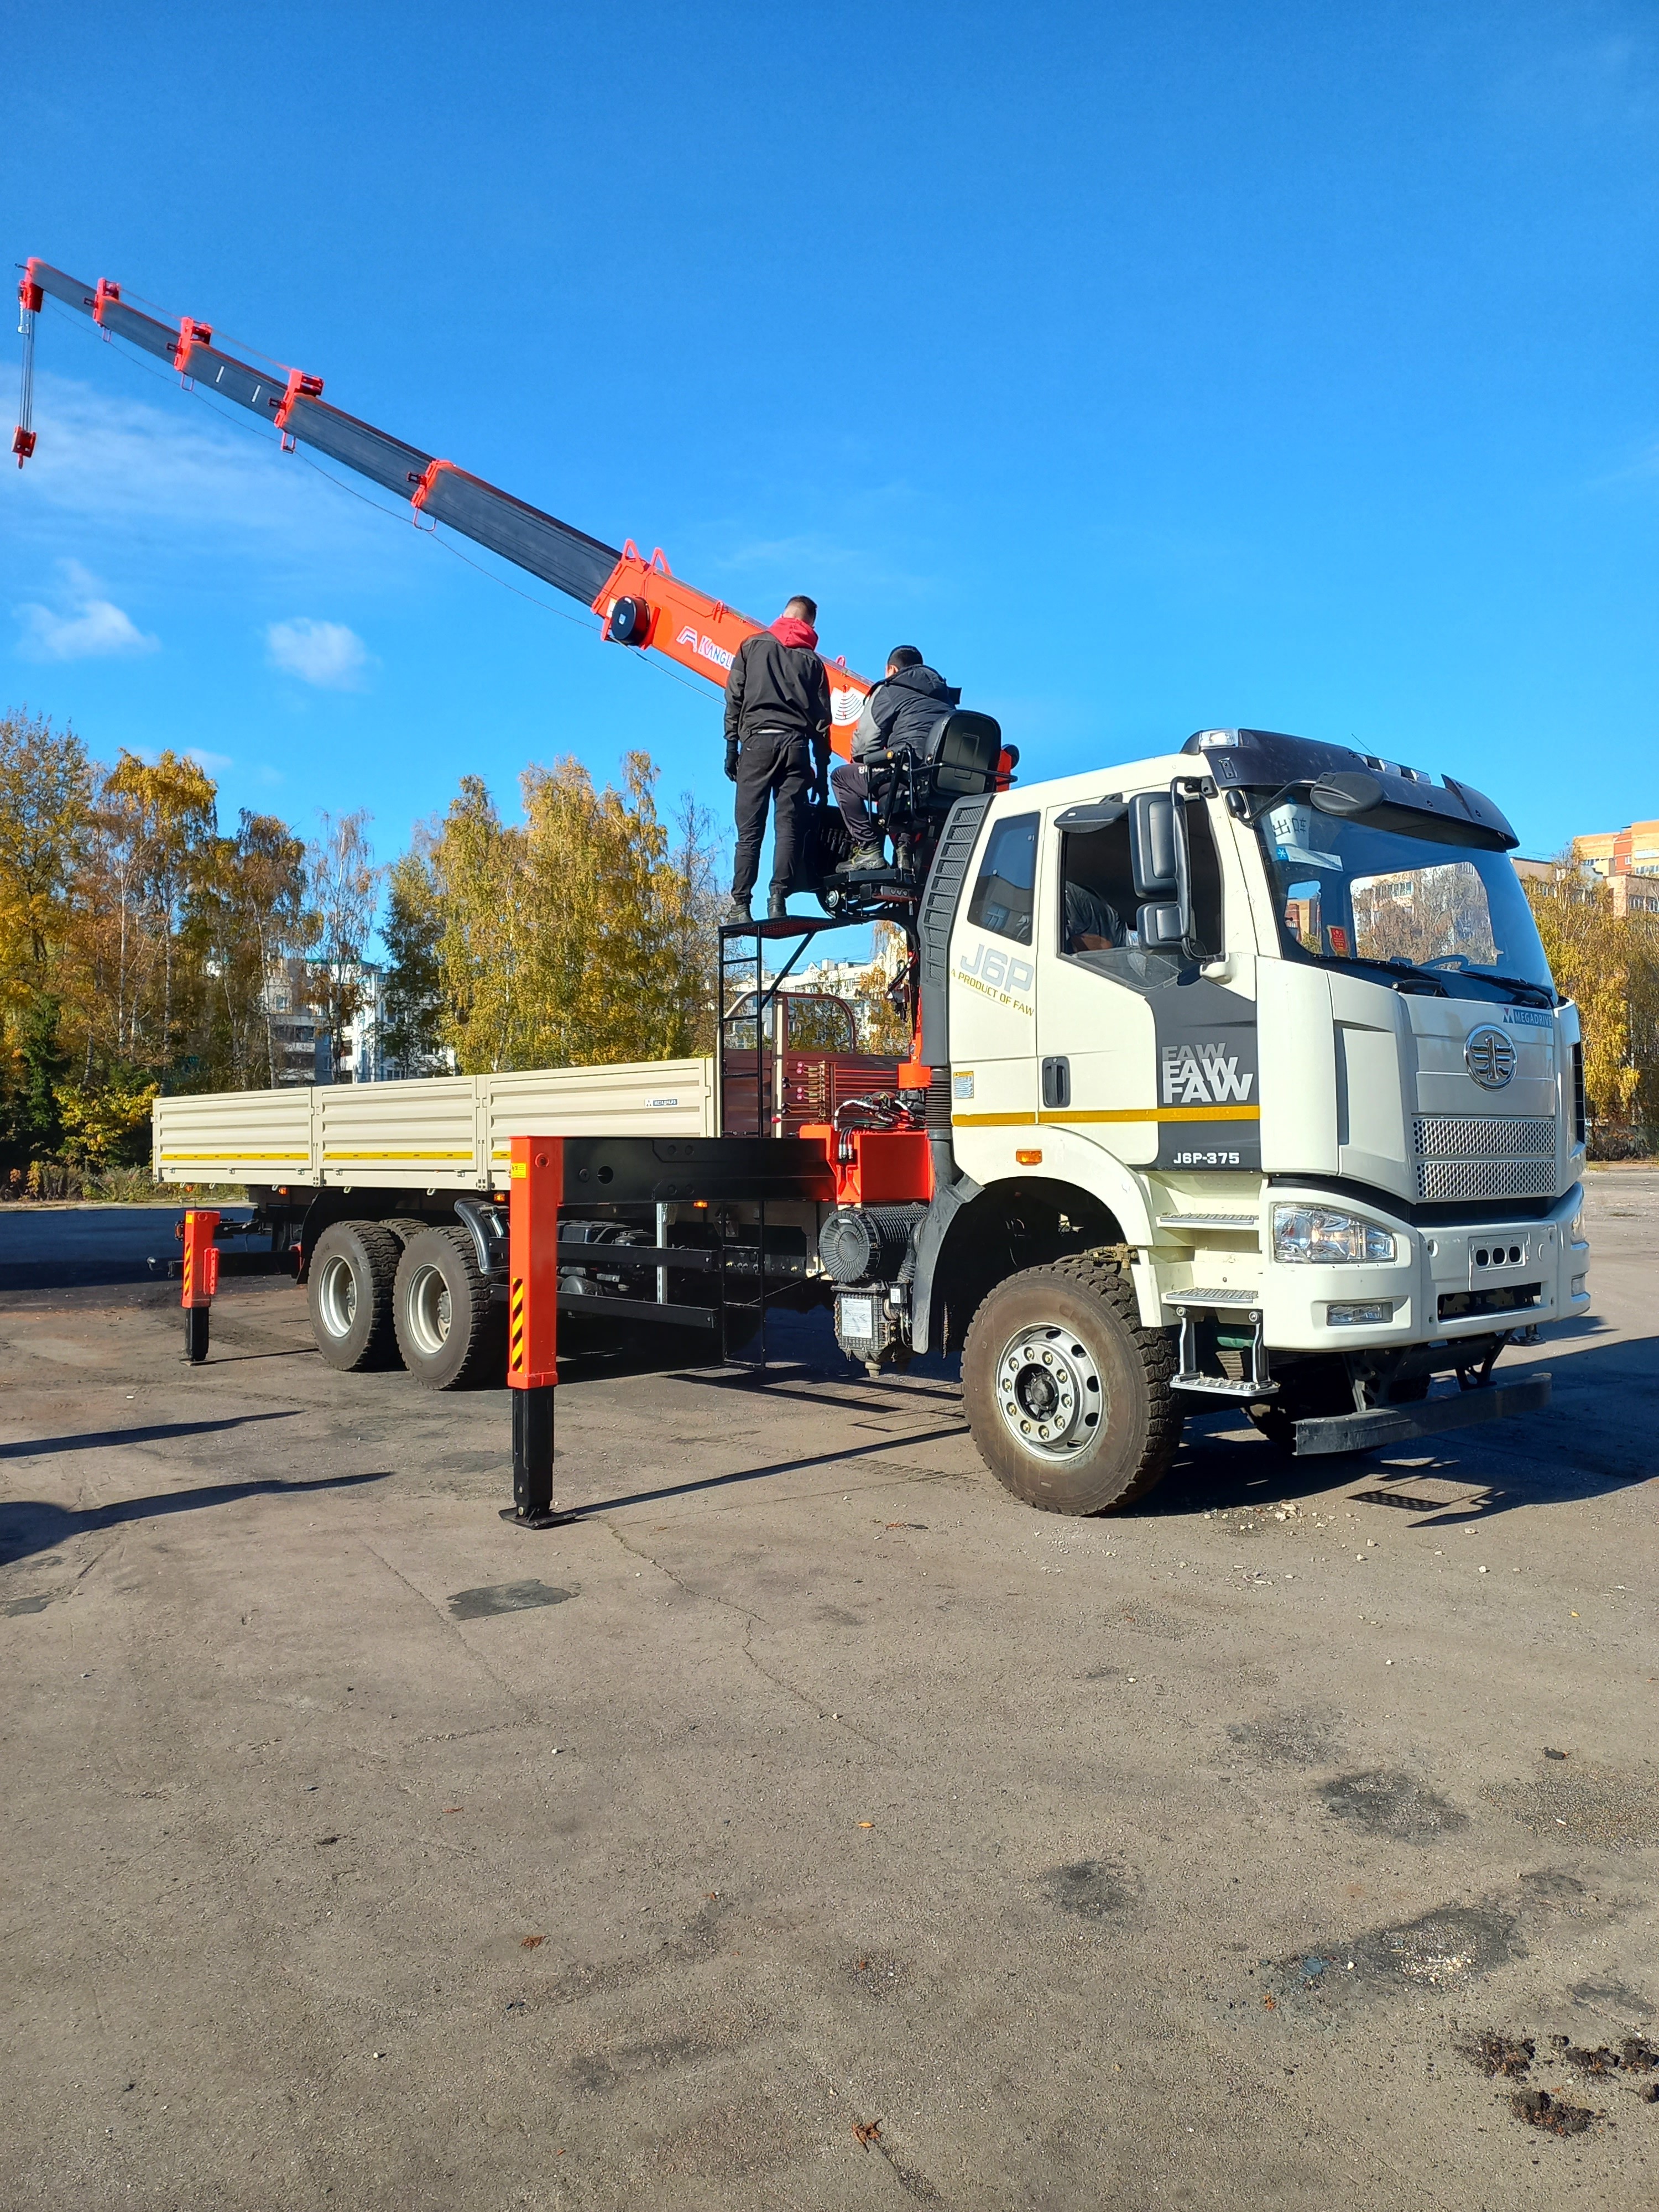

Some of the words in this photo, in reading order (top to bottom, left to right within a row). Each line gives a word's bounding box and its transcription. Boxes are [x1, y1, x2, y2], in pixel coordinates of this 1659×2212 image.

[961, 943, 1034, 993] J6P
[951, 968, 956, 978] A
[958, 972, 998, 998] PRODUCT
[999, 993, 1012, 1004] OF
[1013, 1000, 1034, 1016] FAW
[1515, 1011, 1552, 1026] MEGADRIVE
[1163, 1073, 1254, 1104] FAW
[1173, 1152, 1240, 1164] J6P-375
